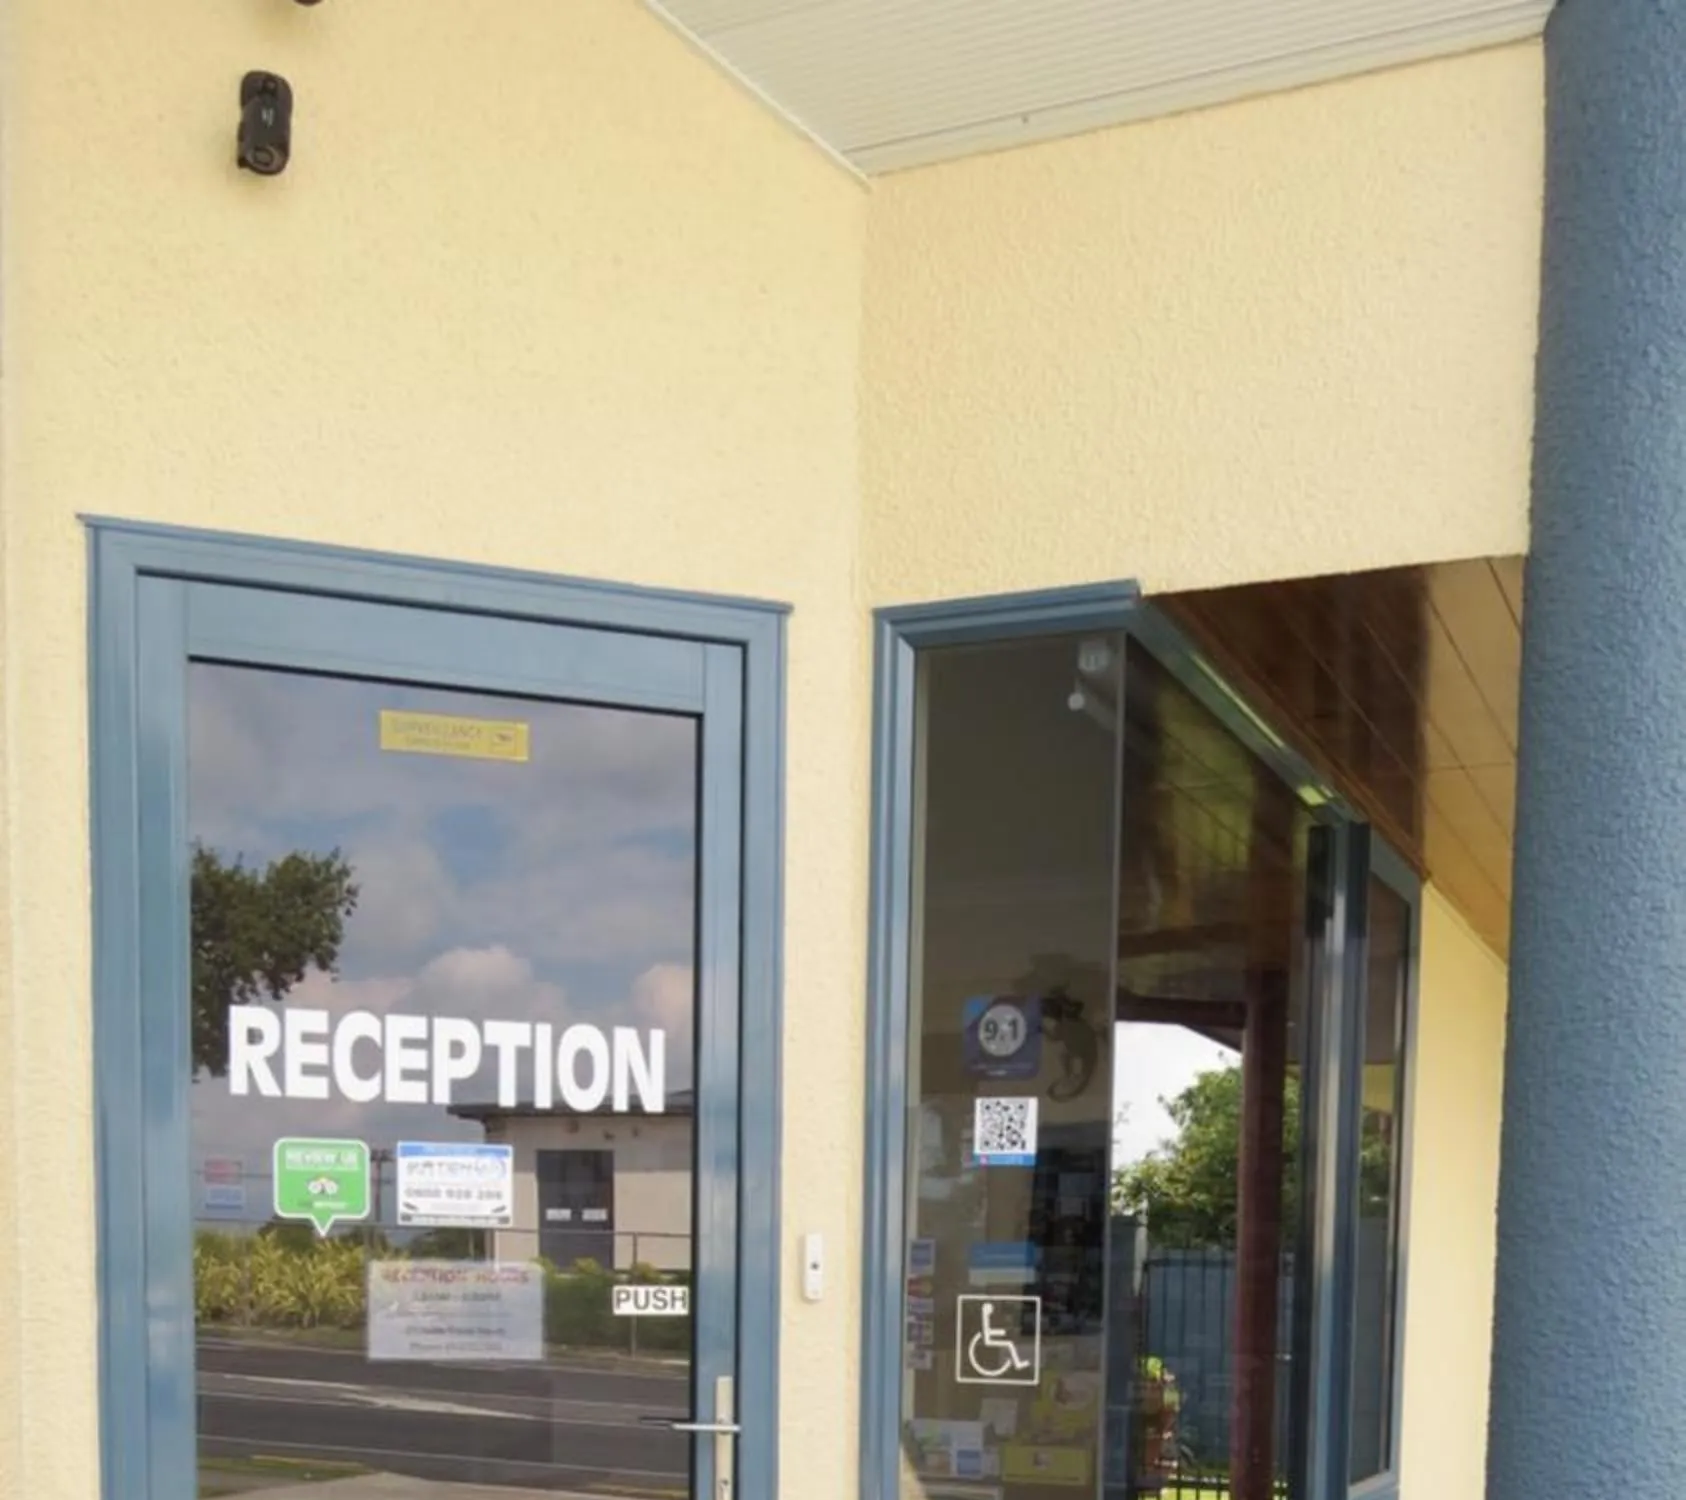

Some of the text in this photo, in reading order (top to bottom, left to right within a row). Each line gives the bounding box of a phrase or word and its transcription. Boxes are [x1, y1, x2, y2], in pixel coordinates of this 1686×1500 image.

[984, 1017, 1018, 1042] 9.1
[229, 1004, 666, 1114] RECEPTION
[615, 1288, 687, 1311] PUSH
